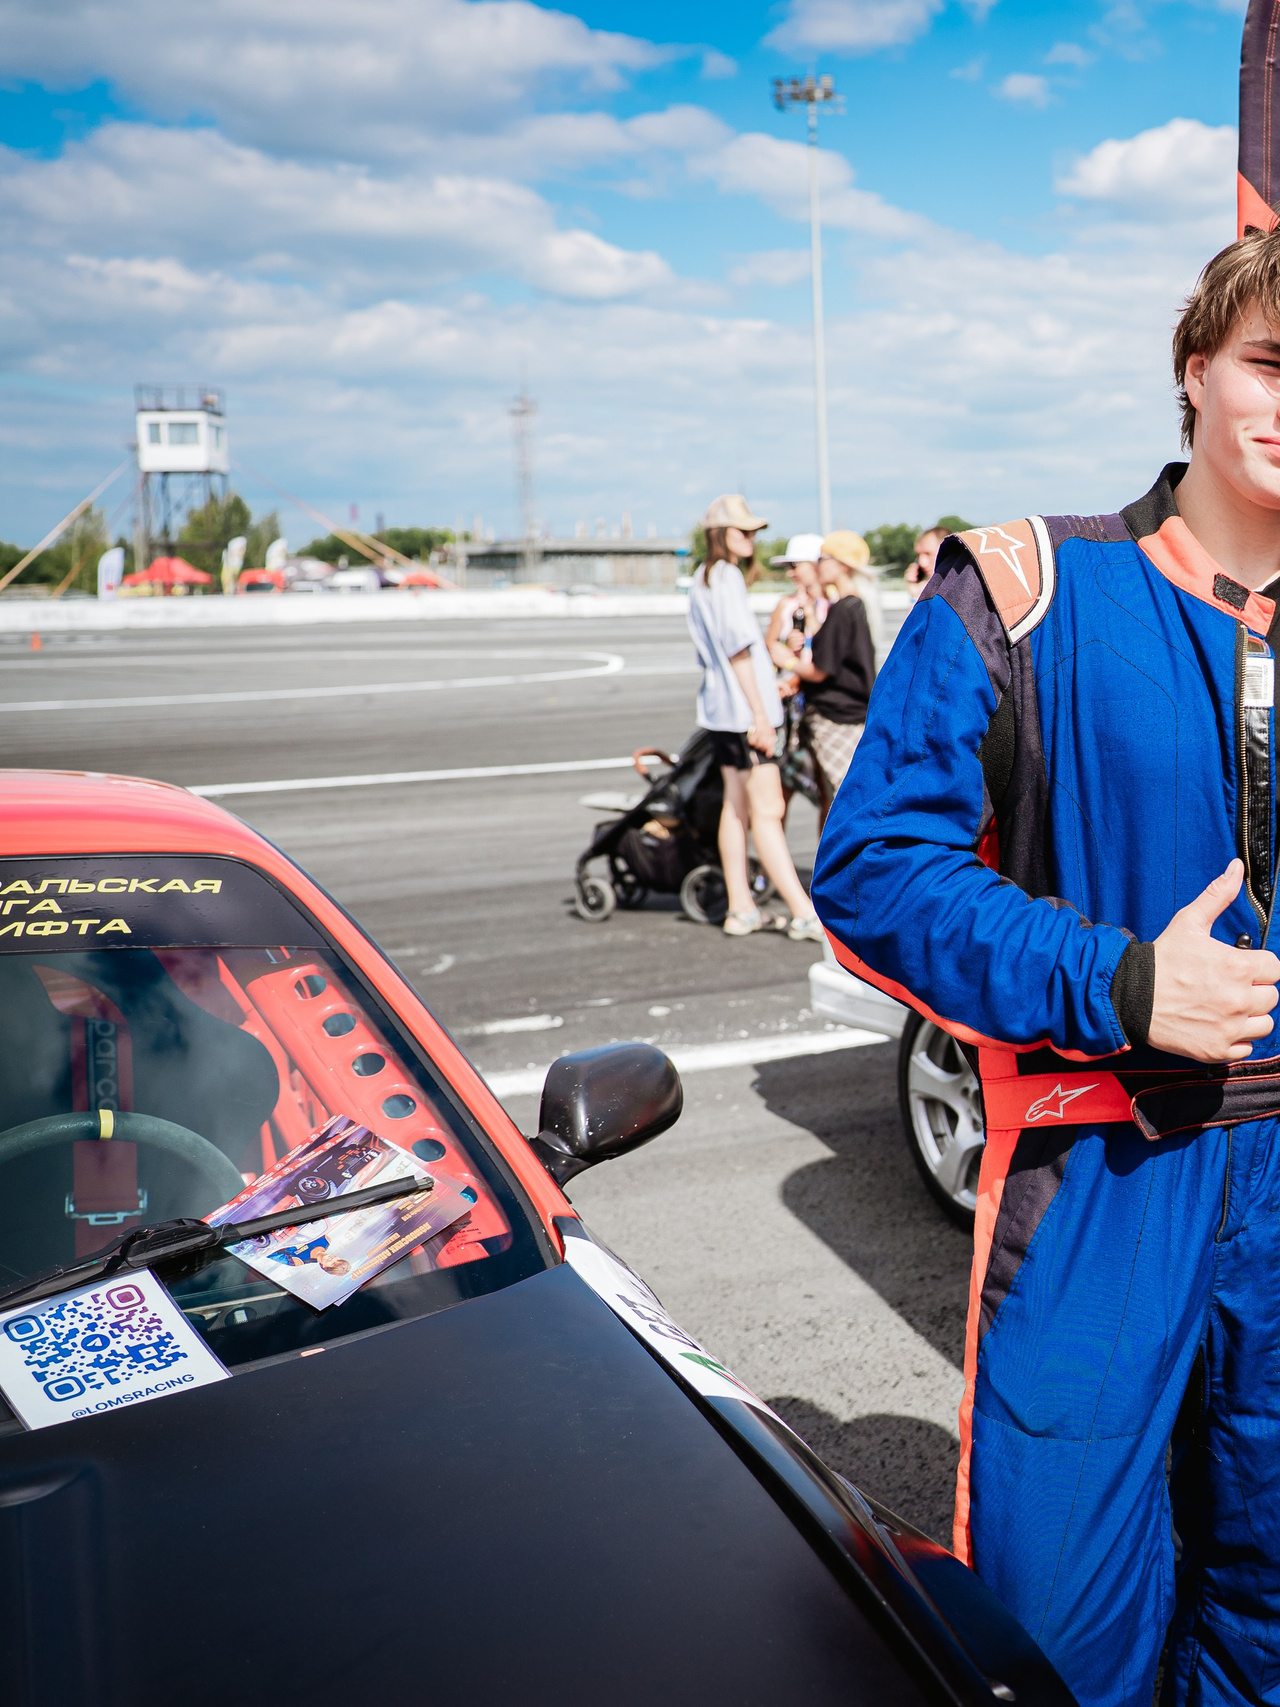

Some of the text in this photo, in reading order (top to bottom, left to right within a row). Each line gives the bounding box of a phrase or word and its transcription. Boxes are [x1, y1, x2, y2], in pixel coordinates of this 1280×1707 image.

[0, 878, 223, 895] АЛЬСКАЯ
[0, 899, 63, 915] ГА
[71, 1373, 195, 1419] @LOMSRACING
